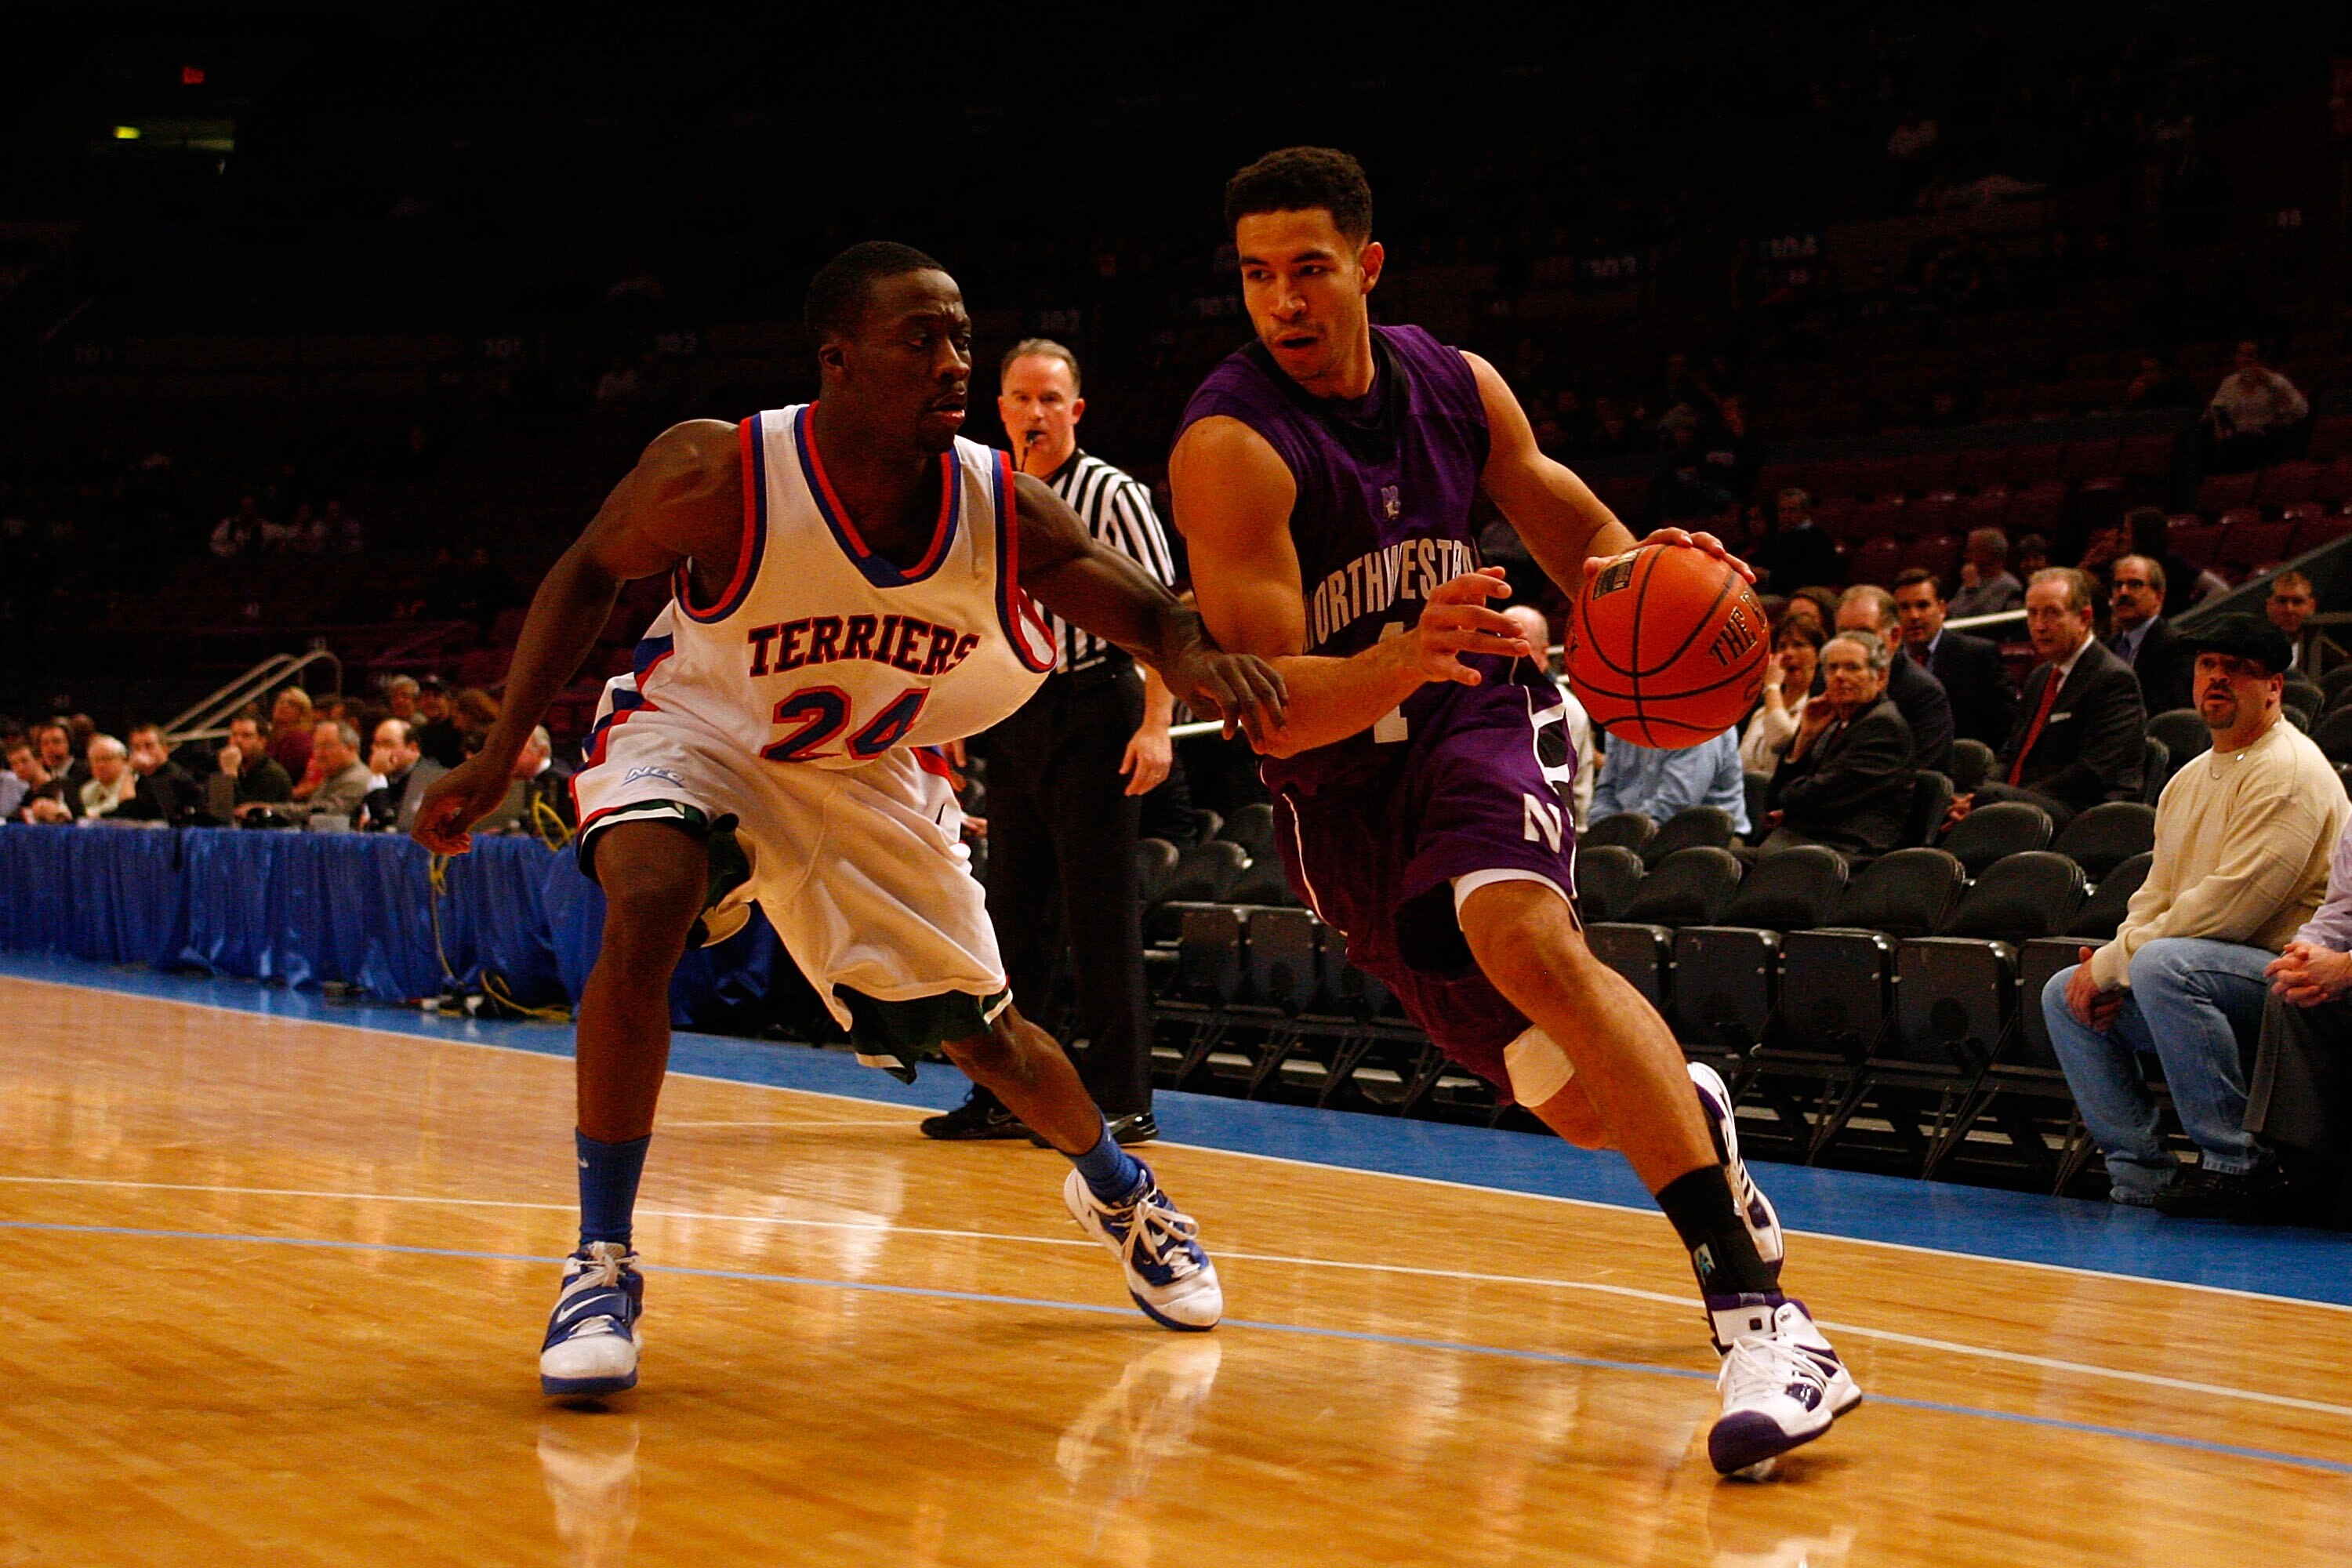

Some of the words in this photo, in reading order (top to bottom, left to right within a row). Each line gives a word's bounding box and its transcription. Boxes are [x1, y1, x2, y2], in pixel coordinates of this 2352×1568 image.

[748, 615, 981, 677] TERRIERS
[1709, 606, 1758, 666] THE
[760, 684, 931, 762] 24
[1523, 793, 1563, 854] N
